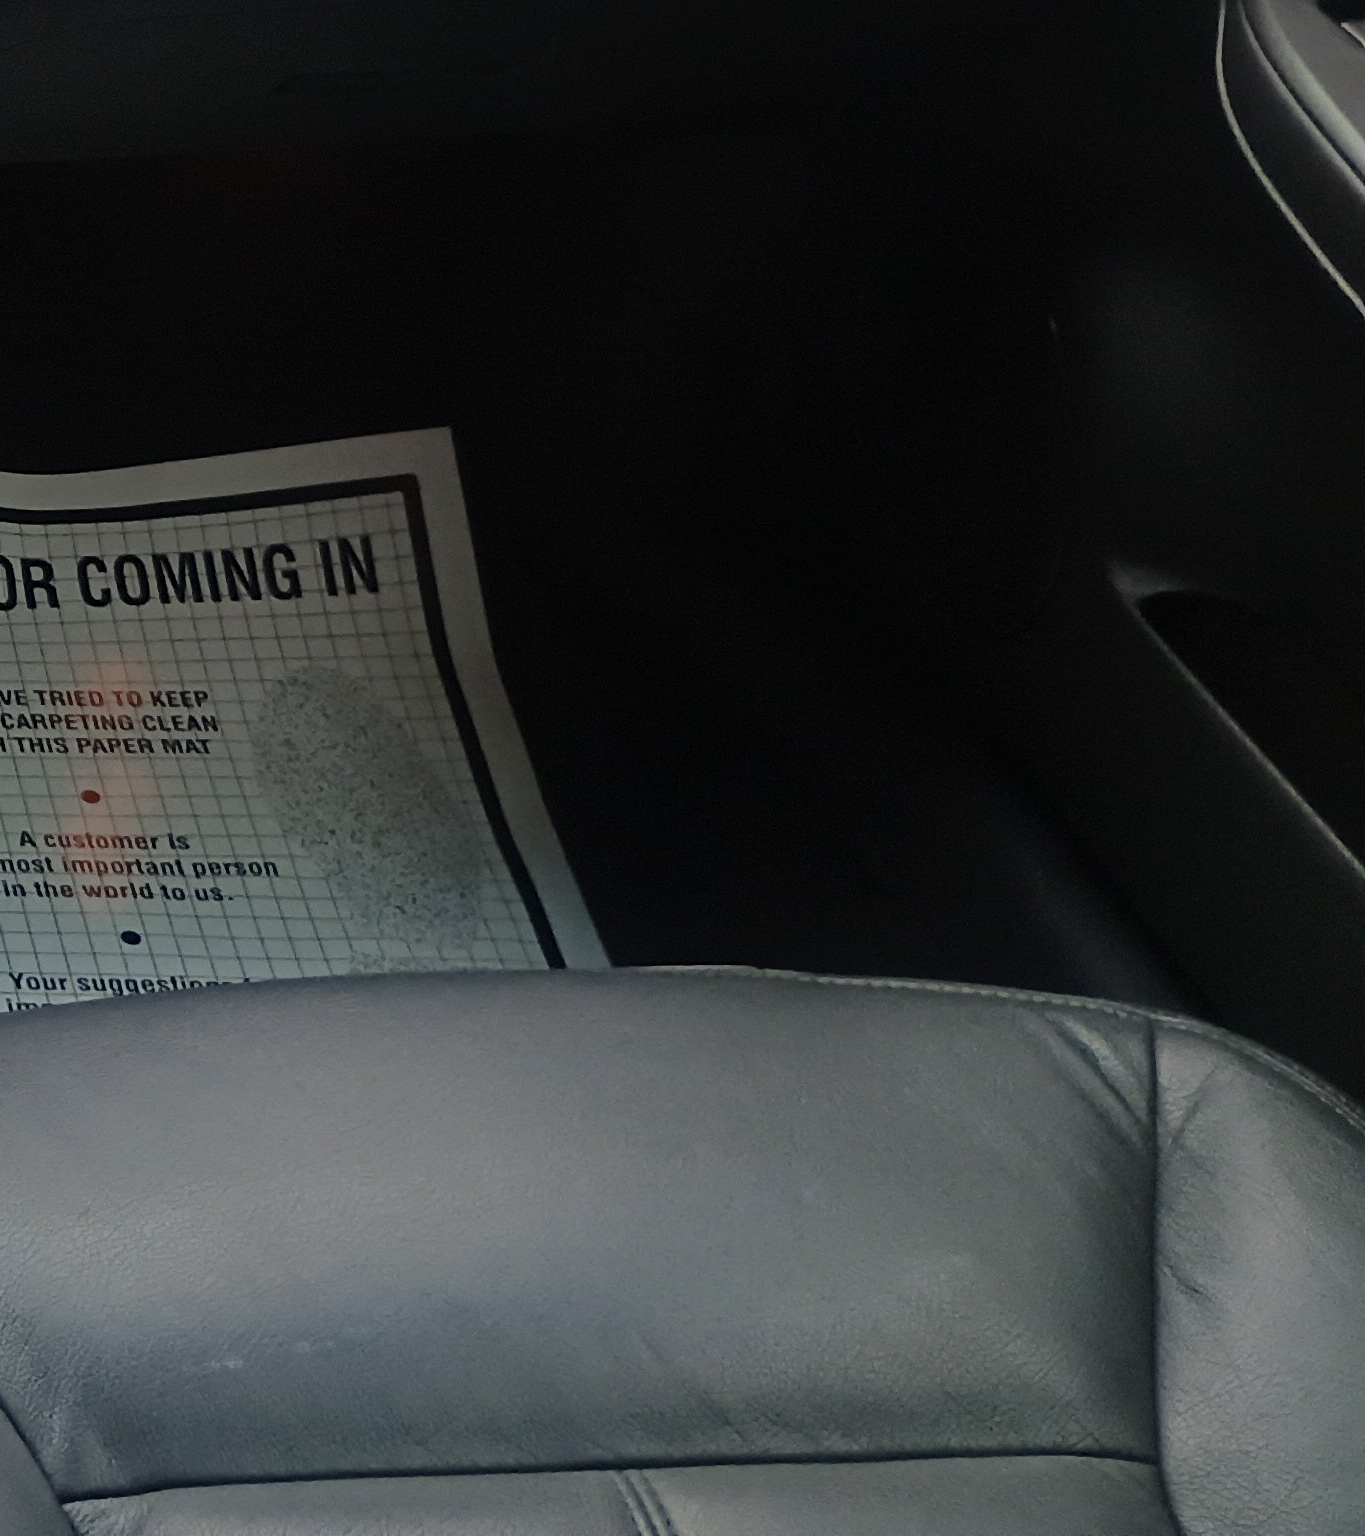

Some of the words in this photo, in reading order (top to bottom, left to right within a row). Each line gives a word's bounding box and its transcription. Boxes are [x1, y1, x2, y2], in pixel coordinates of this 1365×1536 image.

[77, 542, 304, 607] COMING
[318, 534, 379, 597] IN
[32, 688, 104, 708] TRIED
[111, 690, 143, 708] TO
[150, 690, 209, 709] KEEP
[0, 712, 135, 733] CARPETING
[141, 714, 219, 733] CLEAN
[14, 736, 70, 755] THIS
[76, 736, 155, 755] PAPER
[162, 738, 214, 756] MAT
[19, 830, 36, 848] A
[43, 832, 159, 850] customer
[168, 833, 191, 851] is
[62, 854, 186, 877] important
[192, 861, 279, 878] person
[3, 880, 27, 898] in
[33, 882, 74, 899] the
[84, 882, 154, 901] world
[160, 884, 186, 902] to
[194, 887, 235, 902] us.
[8, 972, 67, 992] Your
